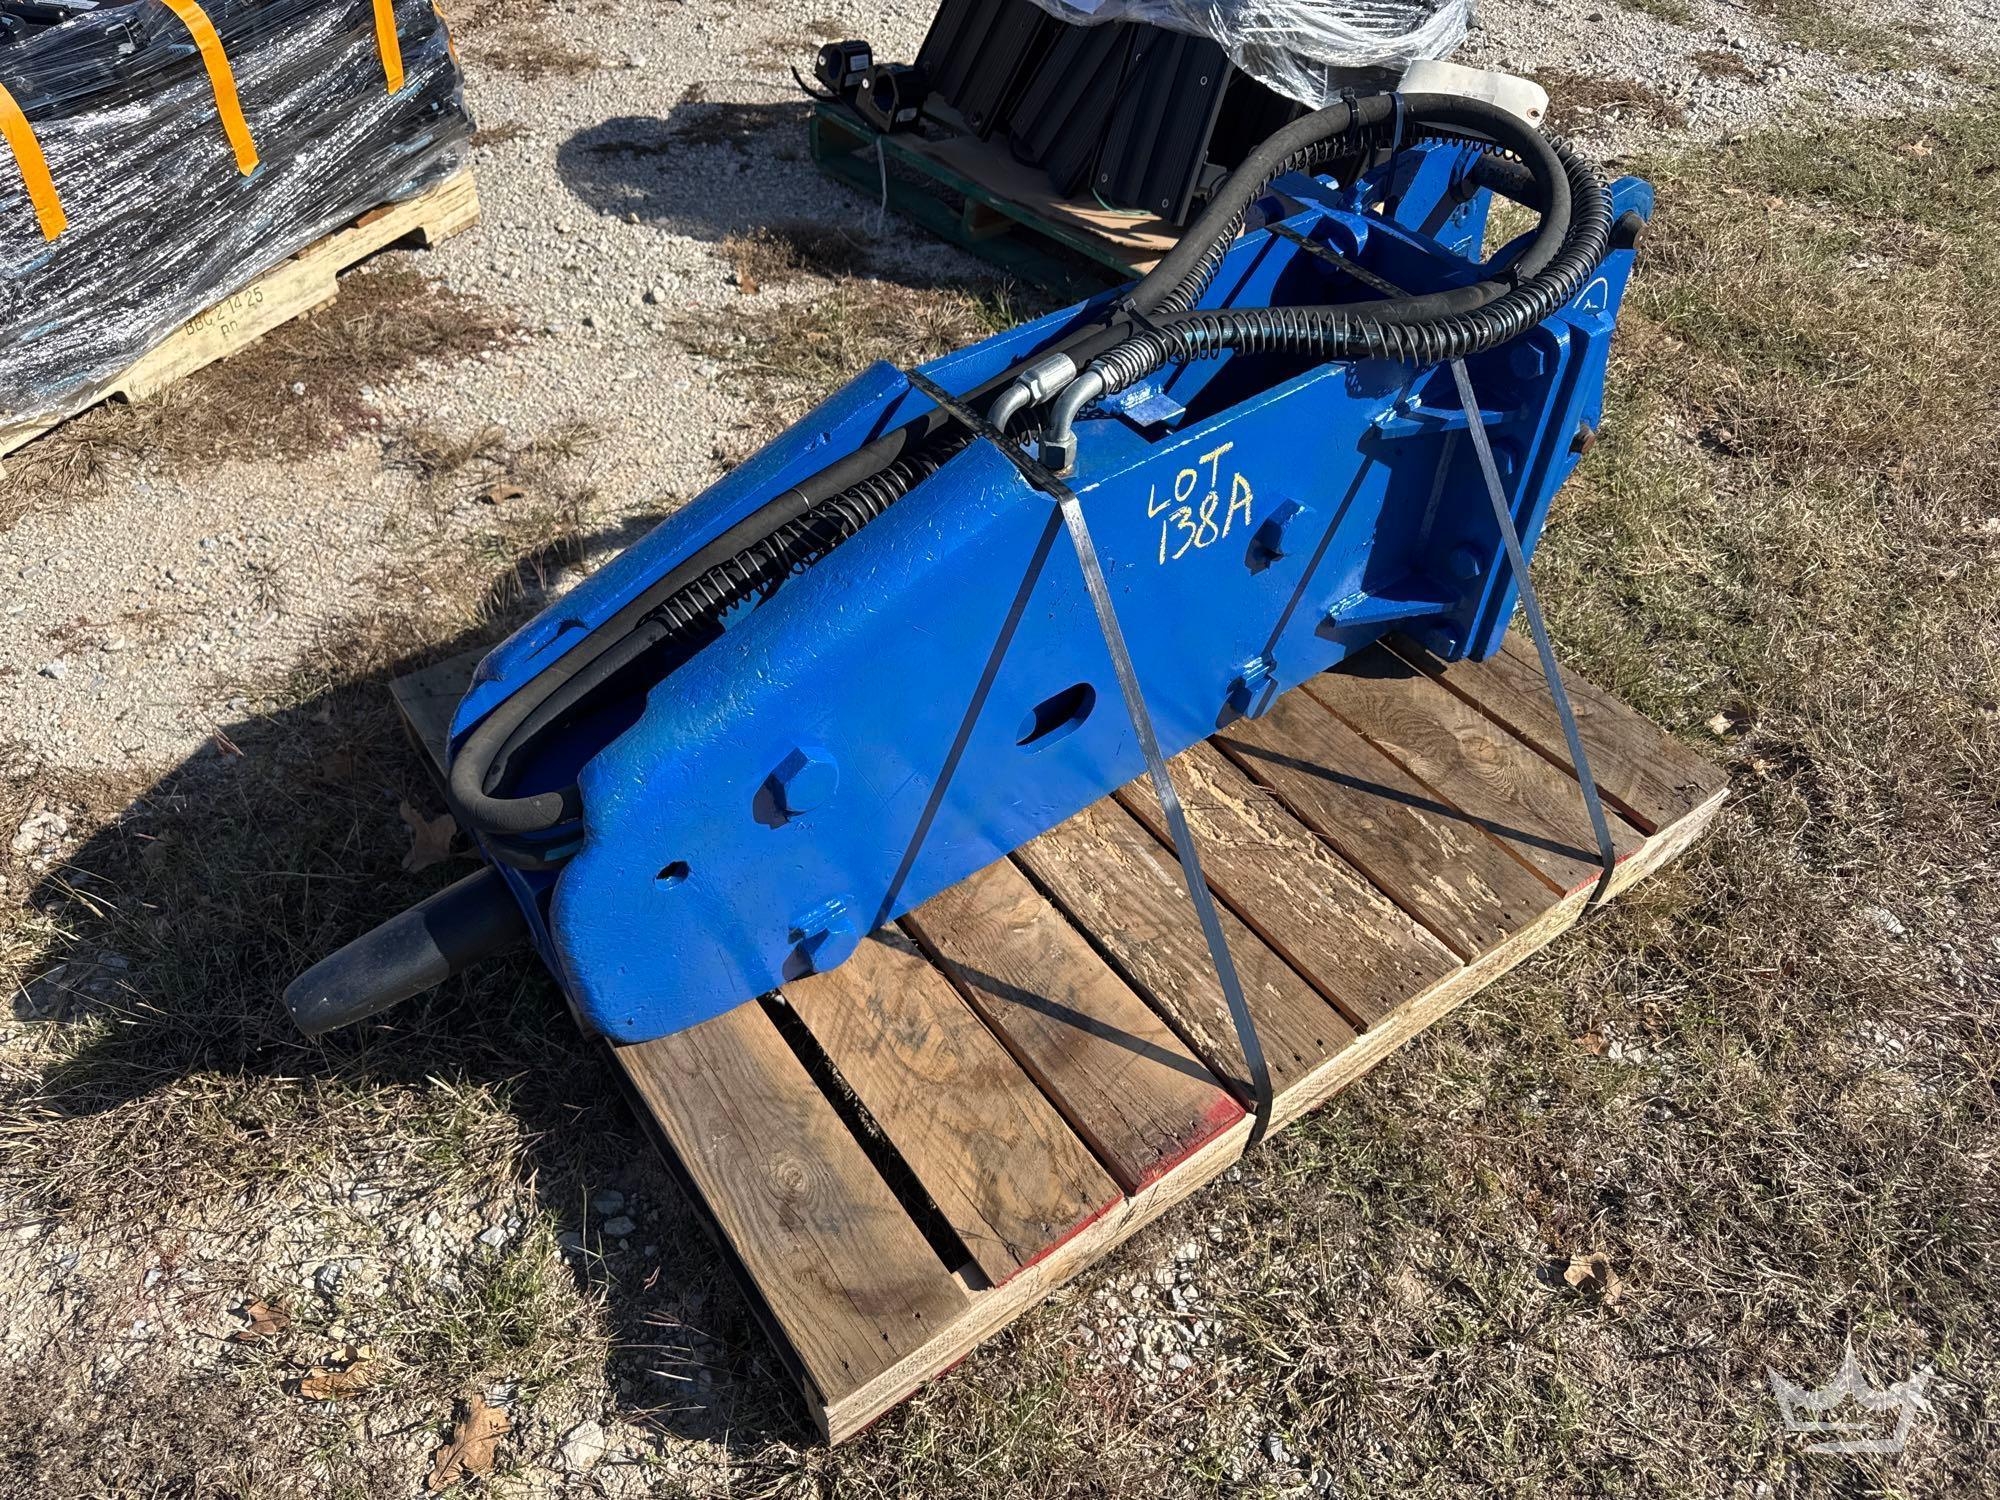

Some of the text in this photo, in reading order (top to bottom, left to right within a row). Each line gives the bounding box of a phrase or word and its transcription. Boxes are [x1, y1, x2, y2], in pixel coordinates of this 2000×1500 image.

[184, 286, 263, 336] BBC 2 14 25
[1147, 440, 1234, 519] LOT
[1158, 472, 1254, 566] 138A
